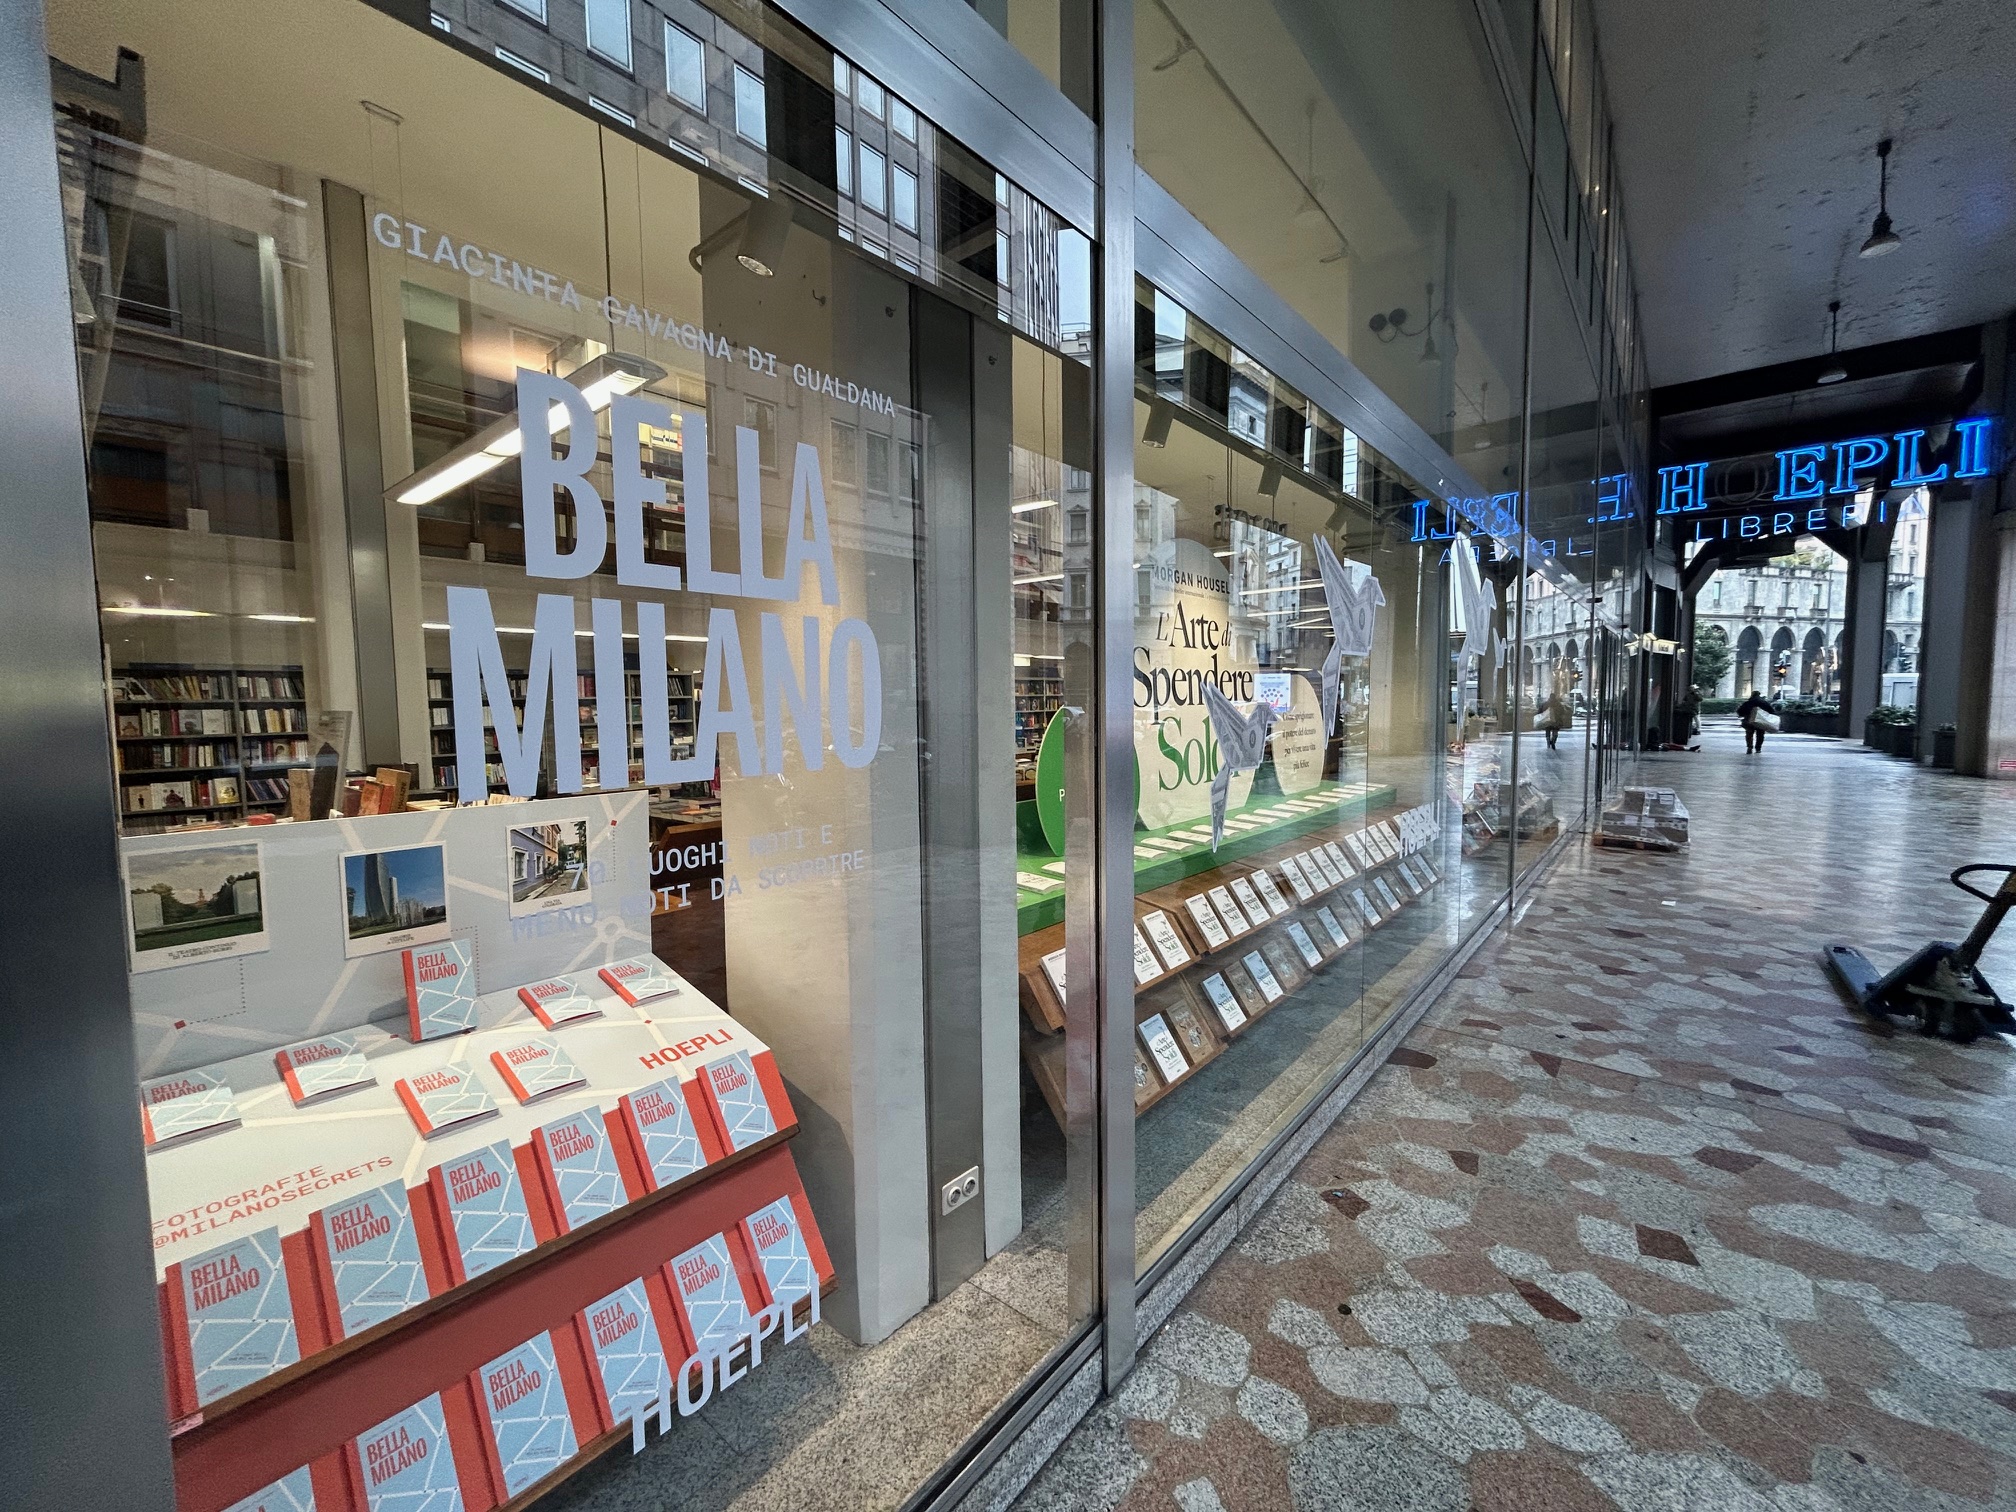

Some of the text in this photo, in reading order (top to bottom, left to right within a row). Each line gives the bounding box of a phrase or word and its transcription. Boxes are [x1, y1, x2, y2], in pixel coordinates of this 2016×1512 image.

[372, 212, 897, 418] GIACINTA CAVAGNA DI GUALDANA
[1655, 418, 1992, 515] HOEPLI
[516, 366, 840, 606] BELLA
[1153, 565, 1194, 587] MORGAN
[1197, 574, 1231, 595] HOUSEL
[1221, 621, 1233, 648] di
[447, 586, 883, 803] MILANO
[1134, 647, 1254, 725] Spendere
[1158, 716, 1241, 792] Sol
[630, 838, 734, 880] UOGHI
[821, 824, 834, 844] E
[711, 875, 743, 902] DA
[417, 952, 448, 969] BELLA
[419, 963, 458, 983] MILANO
[612, 963, 635, 975] BELLA
[615, 966, 645, 979] MILANO
[531, 982, 557, 993] BELLA
[534, 984, 569, 999] MILANO
[293, 1043, 328, 1058] BELLA
[295, 1047, 342, 1065] MILANO
[506, 1045, 536, 1060] BELLA
[510, 1049, 549, 1066] MILANO
[639, 1028, 733, 1070] HOEPLI
[151, 1079, 190, 1096] BELLA
[412, 1072, 446, 1087] BELLA
[416, 1076, 461, 1094] MILANO
[712, 1063, 737, 1083] BELLA
[716, 1073, 748, 1096] MILANO
[153, 1084, 207, 1104] MILANO
[635, 1092, 664, 1113] BELLA
[639, 1102, 676, 1128] MILANO
[549, 1123, 581, 1148] BELLA
[553, 1134, 595, 1163] MILANO
[449, 1160, 486, 1187] BELLA
[453, 1171, 502, 1205] MILANO
[152, 1165, 326, 1233] FOTOGRAFIE
[154, 1156, 393, 1249] @MILANOSECRETS
[331, 1203, 374, 1235] BELLA
[753, 1214, 778, 1237] BELLA
[334, 1215, 391, 1254] MILANO
[757, 1222, 789, 1251] MILANO
[190, 1254, 242, 1290] BELLA
[678, 1254, 708, 1280] BELLA
[682, 1263, 720, 1297] MILANO
[193, 1267, 260, 1312] MILANO
[592, 1302, 625, 1332] BELLA
[596, 1312, 639, 1349] MILANO
[488, 1359, 527, 1394] BELLA
[631, 1272, 822, 1456] HOEPLI
[492, 1370, 542, 1413] MILANO
[366, 1426, 410, 1466] BELLA
[370, 1437, 428, 1488] MILANO
